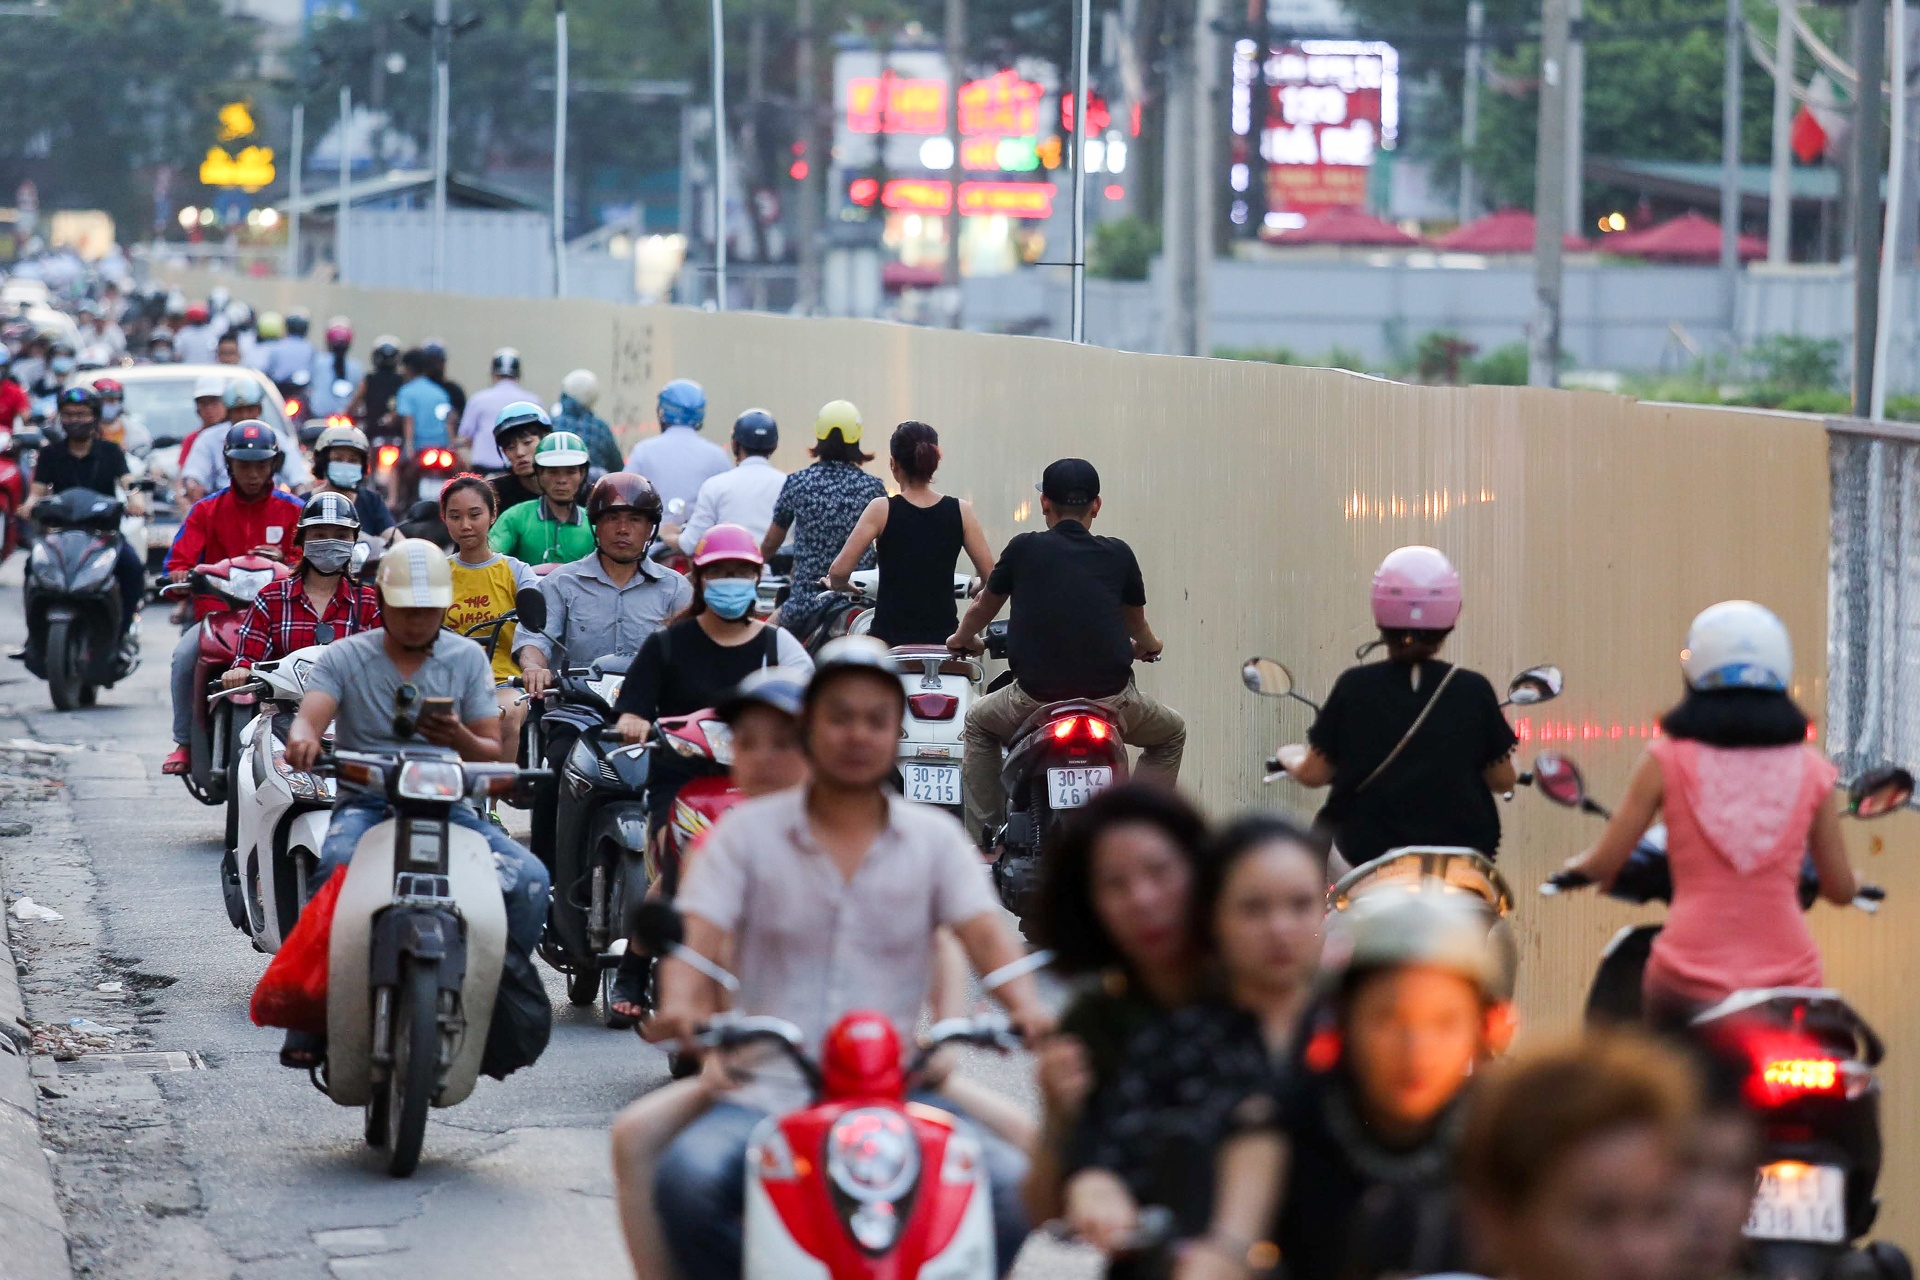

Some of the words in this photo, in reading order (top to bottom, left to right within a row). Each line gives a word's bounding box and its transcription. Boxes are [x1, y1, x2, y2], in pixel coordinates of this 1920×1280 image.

[913, 767, 953, 785] 30-P7
[1057, 769, 1104, 787] 30-K2
[913, 785, 953, 802] 4215
[1059, 788, 1101, 805] 461
